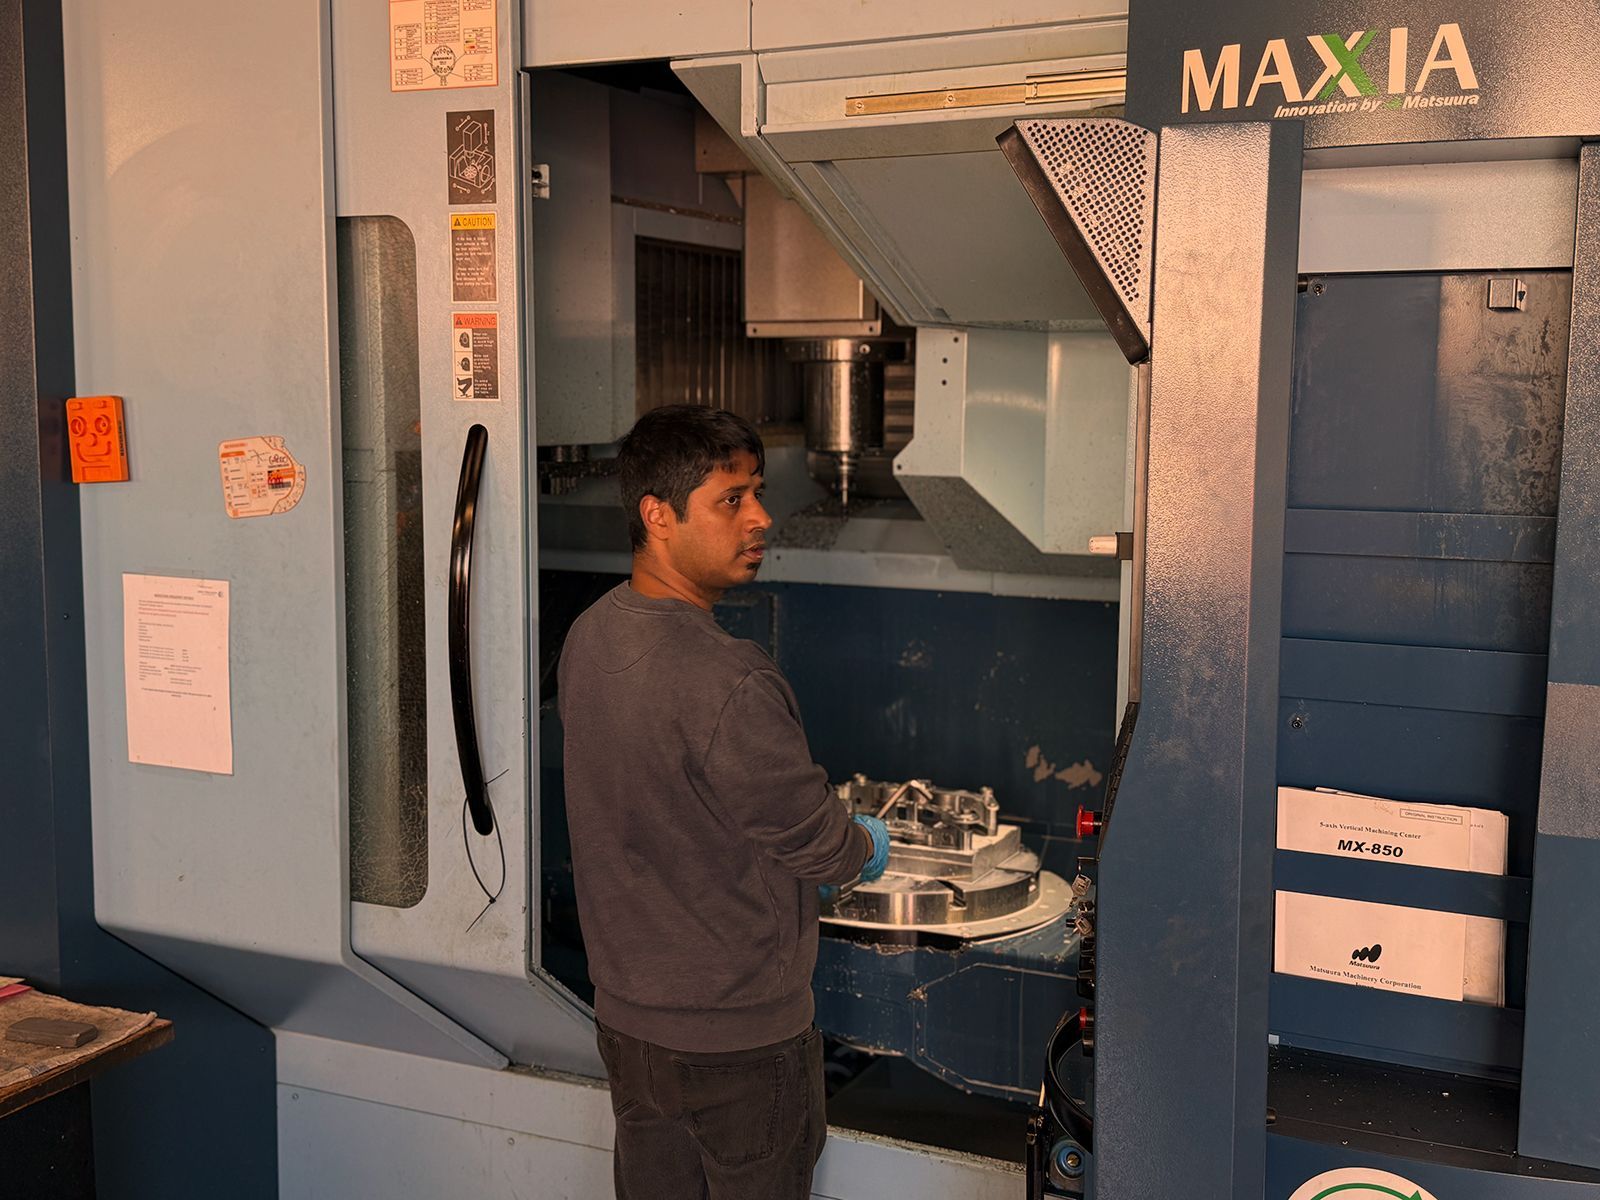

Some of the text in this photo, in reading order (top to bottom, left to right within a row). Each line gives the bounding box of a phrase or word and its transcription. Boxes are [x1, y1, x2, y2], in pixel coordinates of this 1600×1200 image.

[1273, 94, 1480, 118] Innovation by Matsuura
[462, 217, 492, 227] CAUTION
[464, 317, 496, 326] WARNING
[1404, 811, 1458, 822] ORIGINAL INSTRUCTION
[1319, 821, 1422, 840] 5-axis Vertical Machining Center
[1337, 839, 1404, 858] MX-850
[1348, 960, 1380, 970] Matsuura
[1308, 965, 1341, 977] Matsuura
[1342, 970, 1378, 984] Machinery
[1379, 977, 1422, 990] Corporation
